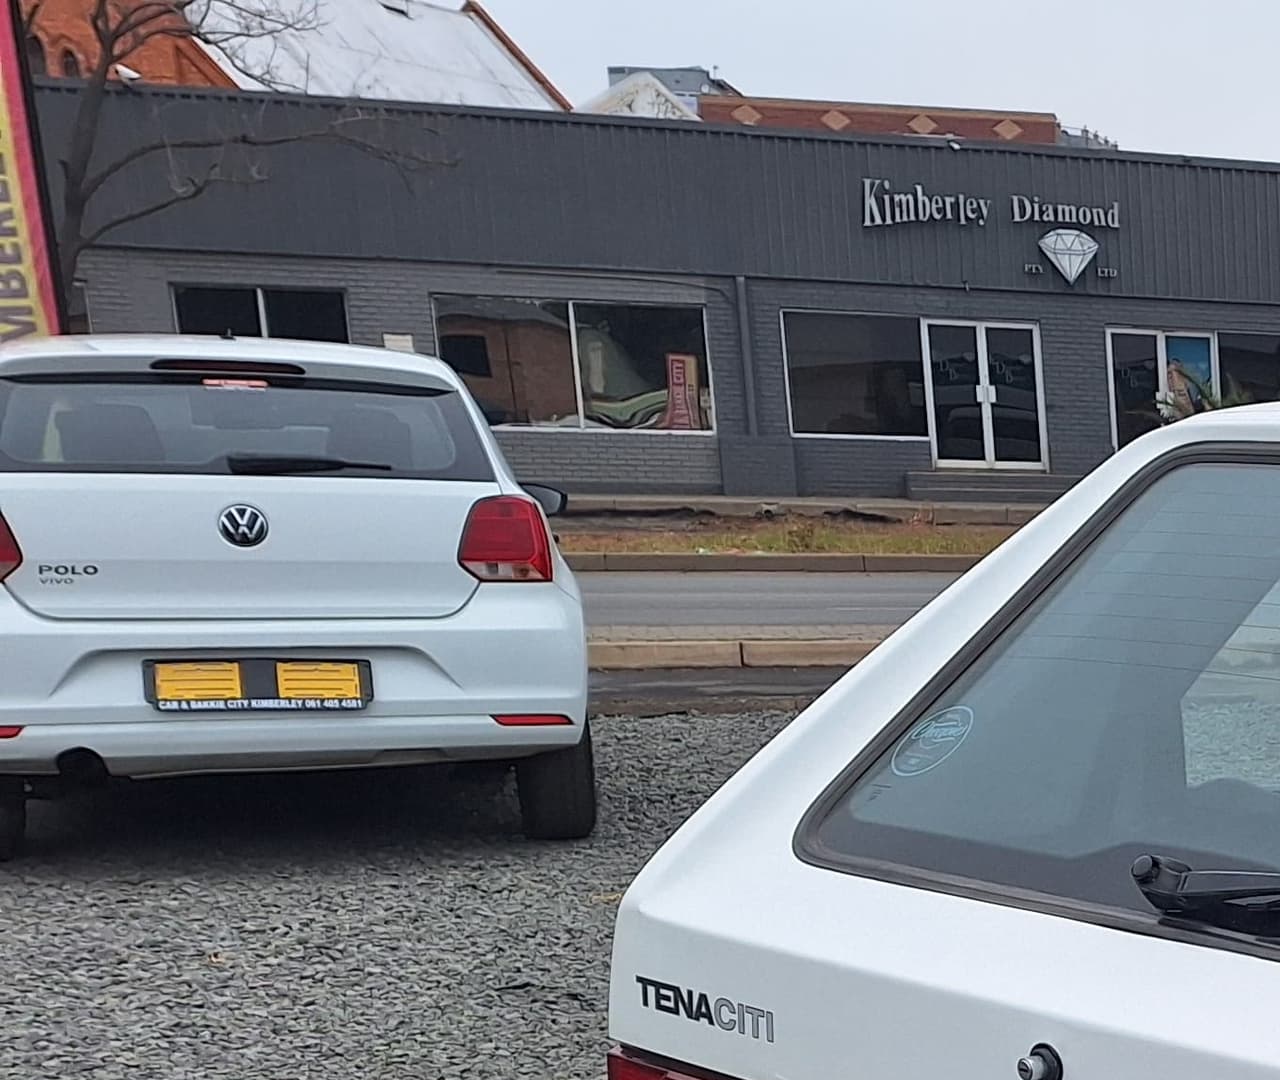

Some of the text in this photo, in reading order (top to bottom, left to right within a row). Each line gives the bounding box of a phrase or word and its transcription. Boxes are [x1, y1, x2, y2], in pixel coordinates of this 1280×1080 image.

[862, 177, 1121, 229] Kimberley Diamond
[38, 565, 99, 575] POLO
[39, 577, 74, 585] VIVO
[635, 974, 775, 1043] TENACITI
